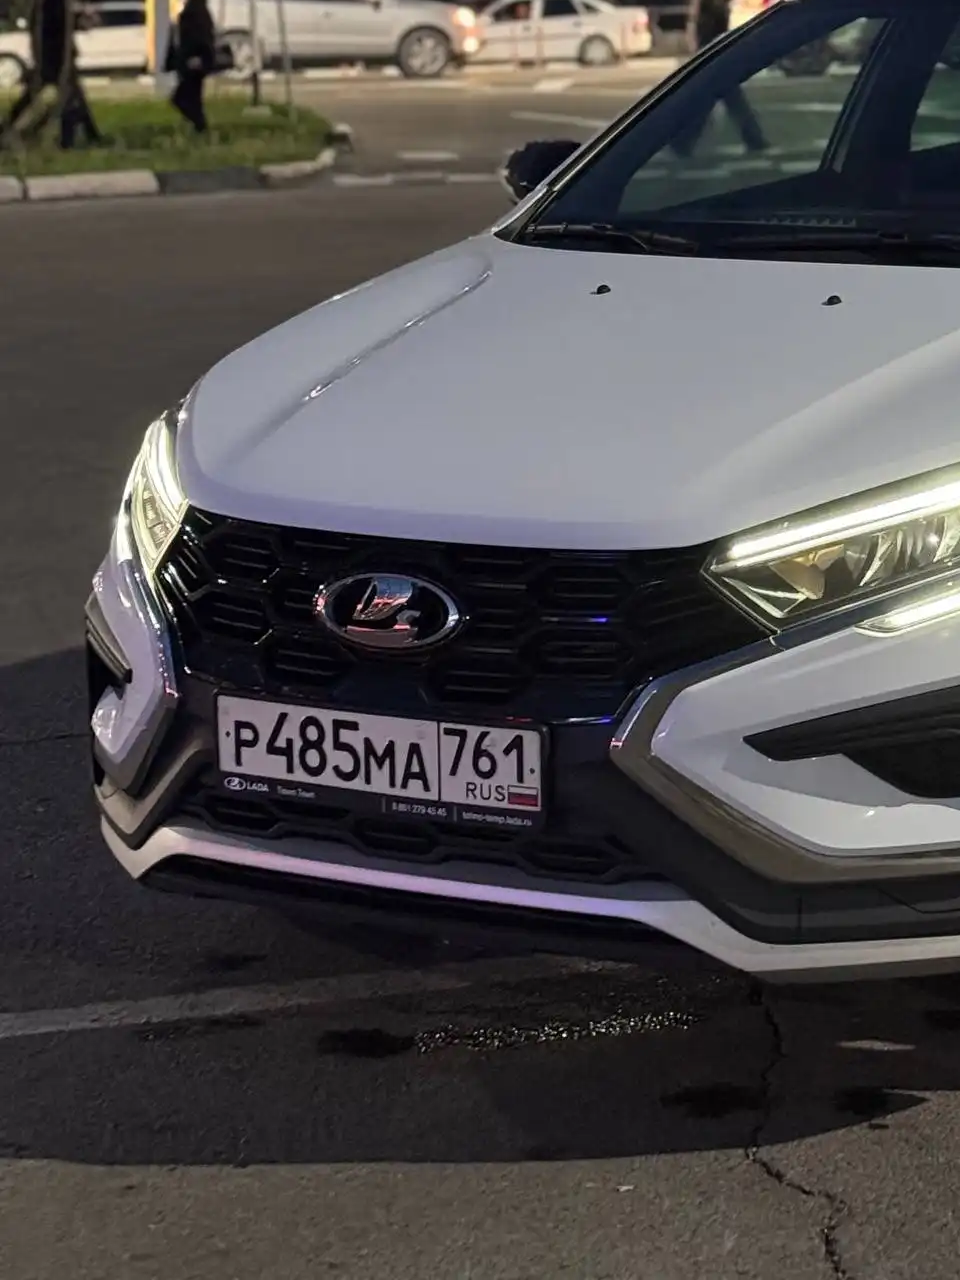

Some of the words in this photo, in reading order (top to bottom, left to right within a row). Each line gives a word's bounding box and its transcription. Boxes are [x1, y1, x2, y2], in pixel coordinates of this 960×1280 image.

[233, 712, 431, 793] Р485МА
[442, 727, 525, 784] 761
[246, 781, 270, 792] LADA
[465, 782, 506, 802] RUS
